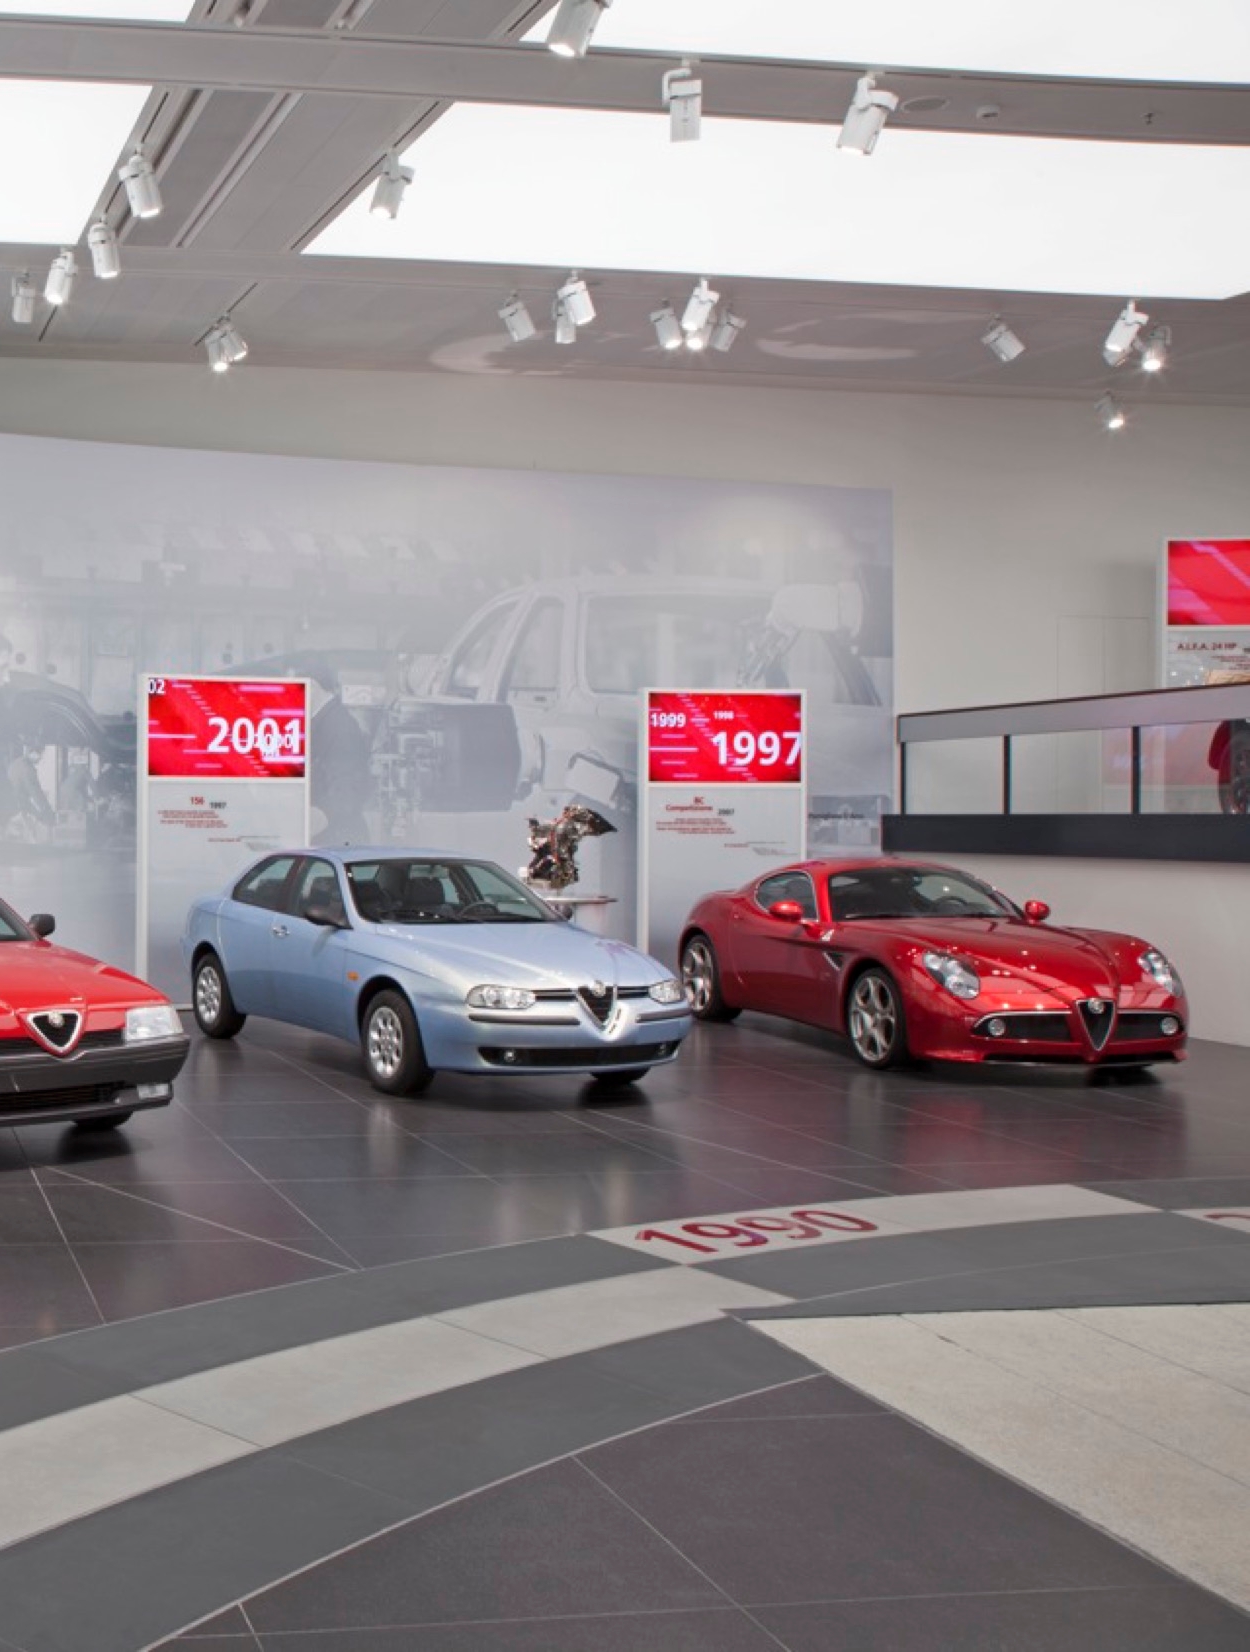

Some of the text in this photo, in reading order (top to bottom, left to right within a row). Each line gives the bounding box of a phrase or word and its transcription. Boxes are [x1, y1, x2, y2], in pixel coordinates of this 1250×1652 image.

[207, 716, 301, 754] 2001
[650, 712, 686, 728] 1999
[712, 731, 802, 766] 1997
[634, 1209, 879, 1254] 1990
